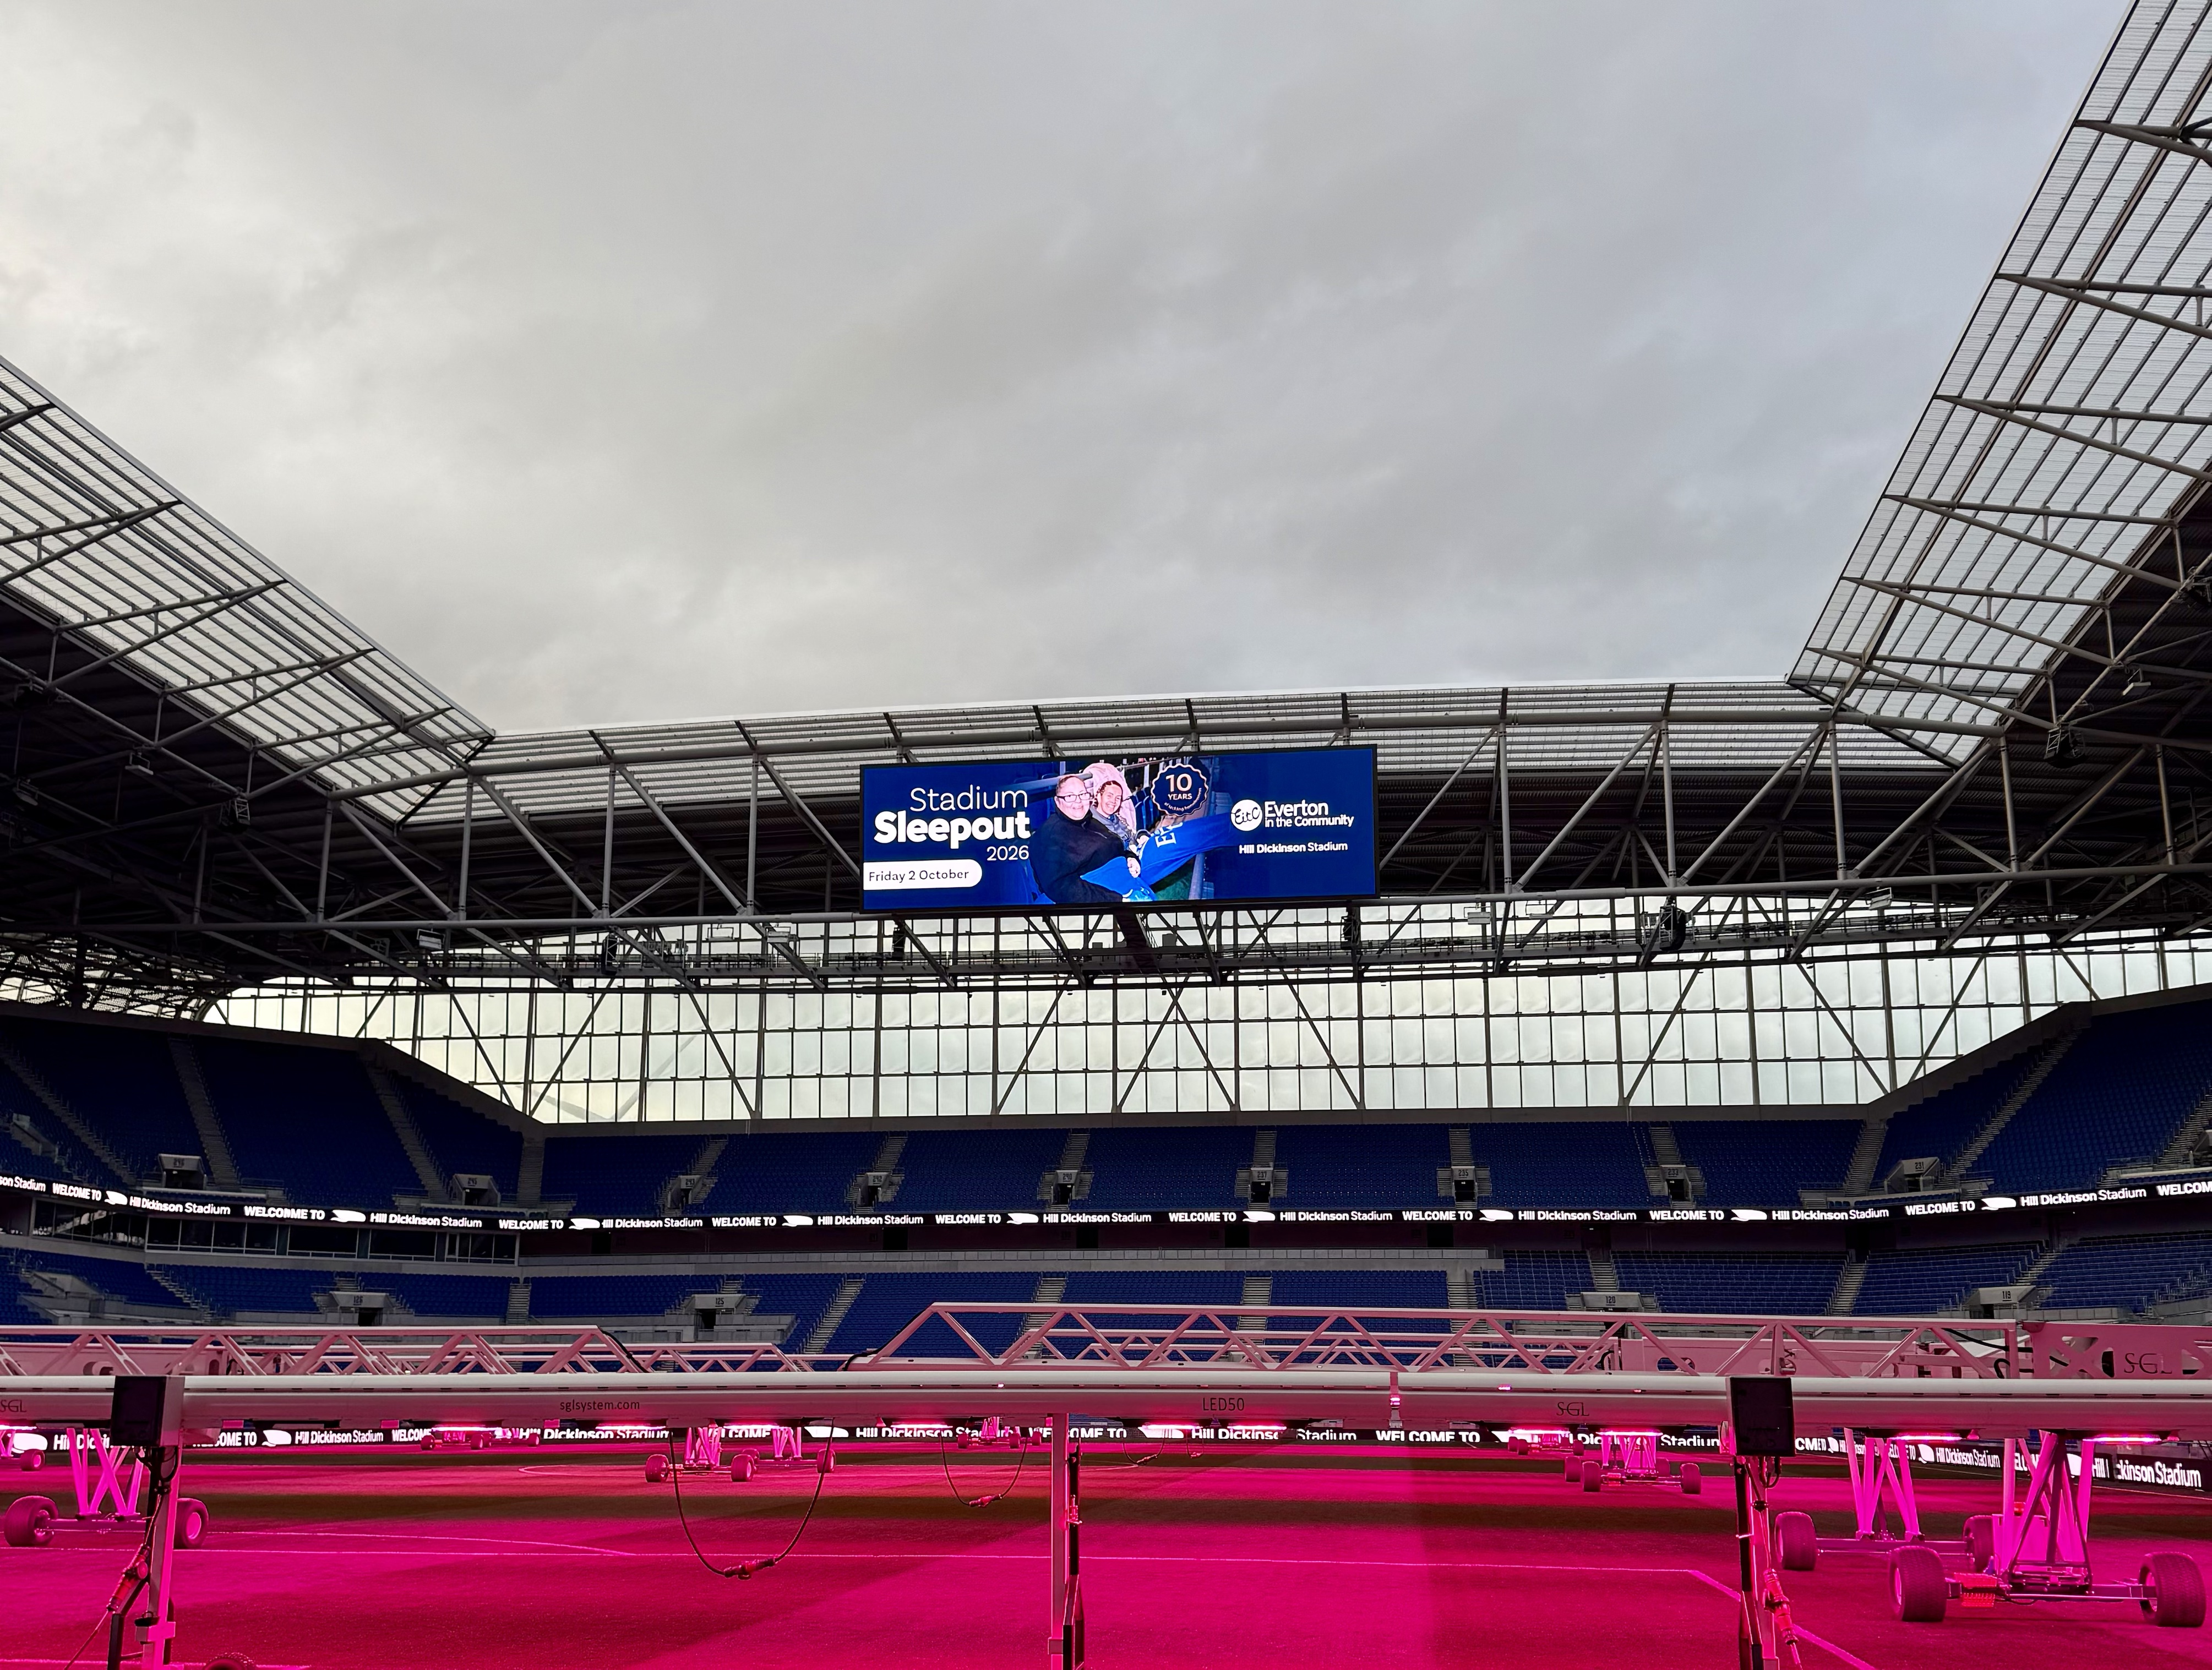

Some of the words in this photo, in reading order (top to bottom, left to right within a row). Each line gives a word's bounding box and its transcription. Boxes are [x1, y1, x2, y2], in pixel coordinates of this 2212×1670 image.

[1166, 774, 1192, 792] 10
[910, 784, 1027, 811] Stadium
[1265, 800, 1328, 817] Everton
[1265, 817, 1273, 827] in
[1276, 817, 1292, 827] the
[1294, 814, 1354, 827] Community
[874, 810, 1031, 849] Sleepout
[987, 845, 1029, 860] 2026
[1239, 844, 1254, 854] Hill
[1257, 844, 1306, 853] Dickinson
[1307, 842, 1348, 852] Stadium
[869, 871, 905, 883] Friday
[908, 871, 916, 880] 2
[919, 869, 969, 880] October
[14, 1176, 46, 1192] Stadium
[53, 1183, 92, 1199] WELCOME
[91, 1189, 101, 1200] TO
[2020, 1196, 2039, 1206] Hill
[2040, 1193, 2097, 1205] Dickinson
[2098, 1188, 2146, 1200] Stadium
[140, 1198, 183, 1212] Dickinson
[185, 1203, 230, 1214] Stadium
[1905, 1202, 1959, 1215] WELCOME
[1960, 1201, 1975, 1211] TO
[309, 1210, 325, 1220] TO
[370, 1213, 387, 1223] Hill
[389, 1214, 440, 1225] Dickinson
[442, 1216, 482, 1227] Stadium
[818, 1216, 833, 1225] Hill
[835, 1215, 882, 1225] Dickinson
[885, 1215, 923, 1224] Stadium
[935, 1214, 985, 1224] WELCOME
[987, 1214, 1001, 1223] TO
[1043, 1214, 1059, 1223] Hill
[1061, 1213, 1110, 1223] Dickinson
[1112, 1213, 1151, 1222] Stadium
[1169, 1213, 1220, 1222] WELCOME
[1222, 1212, 1236, 1221] TO
[1281, 1212, 1296, 1221] Hill
[1298, 1212, 1349, 1221] Dickinson
[1351, 1211, 1392, 1220] Stadium
[1402, 1211, 1456, 1220] WELCOME
[1458, 1211, 1473, 1220] TO
[1518, 1211, 1535, 1220] Hill
[1538, 1211, 1591, 1220] Dickinson
[1593, 1211, 1636, 1220] Stadium
[1649, 1210, 1707, 1220] WELCOME
[1708, 1210, 1724, 1220] TO
[1772, 1210, 1790, 1220] Hill
[1792, 1210, 1848, 1220] Dickinson
[1849, 1208, 1889, 1219] Stadium
[499, 1219, 549, 1230] WELCOME
[551, 1220, 564, 1229] TO
[615, 1219, 663, 1227] Dickinson
[664, 1218, 702, 1227] Stadium
[712, 1217, 761, 1226] WELCOME
[763, 1217, 776, 1226] TO
[1606, 1296, 1616, 1304] 120
[2002, 1291, 2011, 1299] 119
[2123, 1352, 2172, 1374] SGL
[0, 1400, 26, 1412] SGL
[560, 1399, 640, 1412] sglsystem.com
[1202, 1398, 1245, 1411] LED50
[1556, 1401, 1590, 1417] SGL
[243, 1432, 257, 1445] TO
[295, 1432, 309, 1444] Hill
[310, 1431, 351, 1444] Dickinson
[353, 1430, 383, 1443] Stadium
[544, 1428, 614, 1439] Dickinson
[856, 1428, 878, 1437] Hill
[1107, 1428, 1126, 1438] TO
[1192, 1428, 1214, 1439] Hill
[1296, 1429, 1356, 1440] Stadium
[1459, 1432, 1480, 1442] TO
[1946, 1448, 1973, 1465] Dickinson
[1973, 1449, 2000, 1467] Stadium
[2155, 1461, 2201, 1487] Stadium
